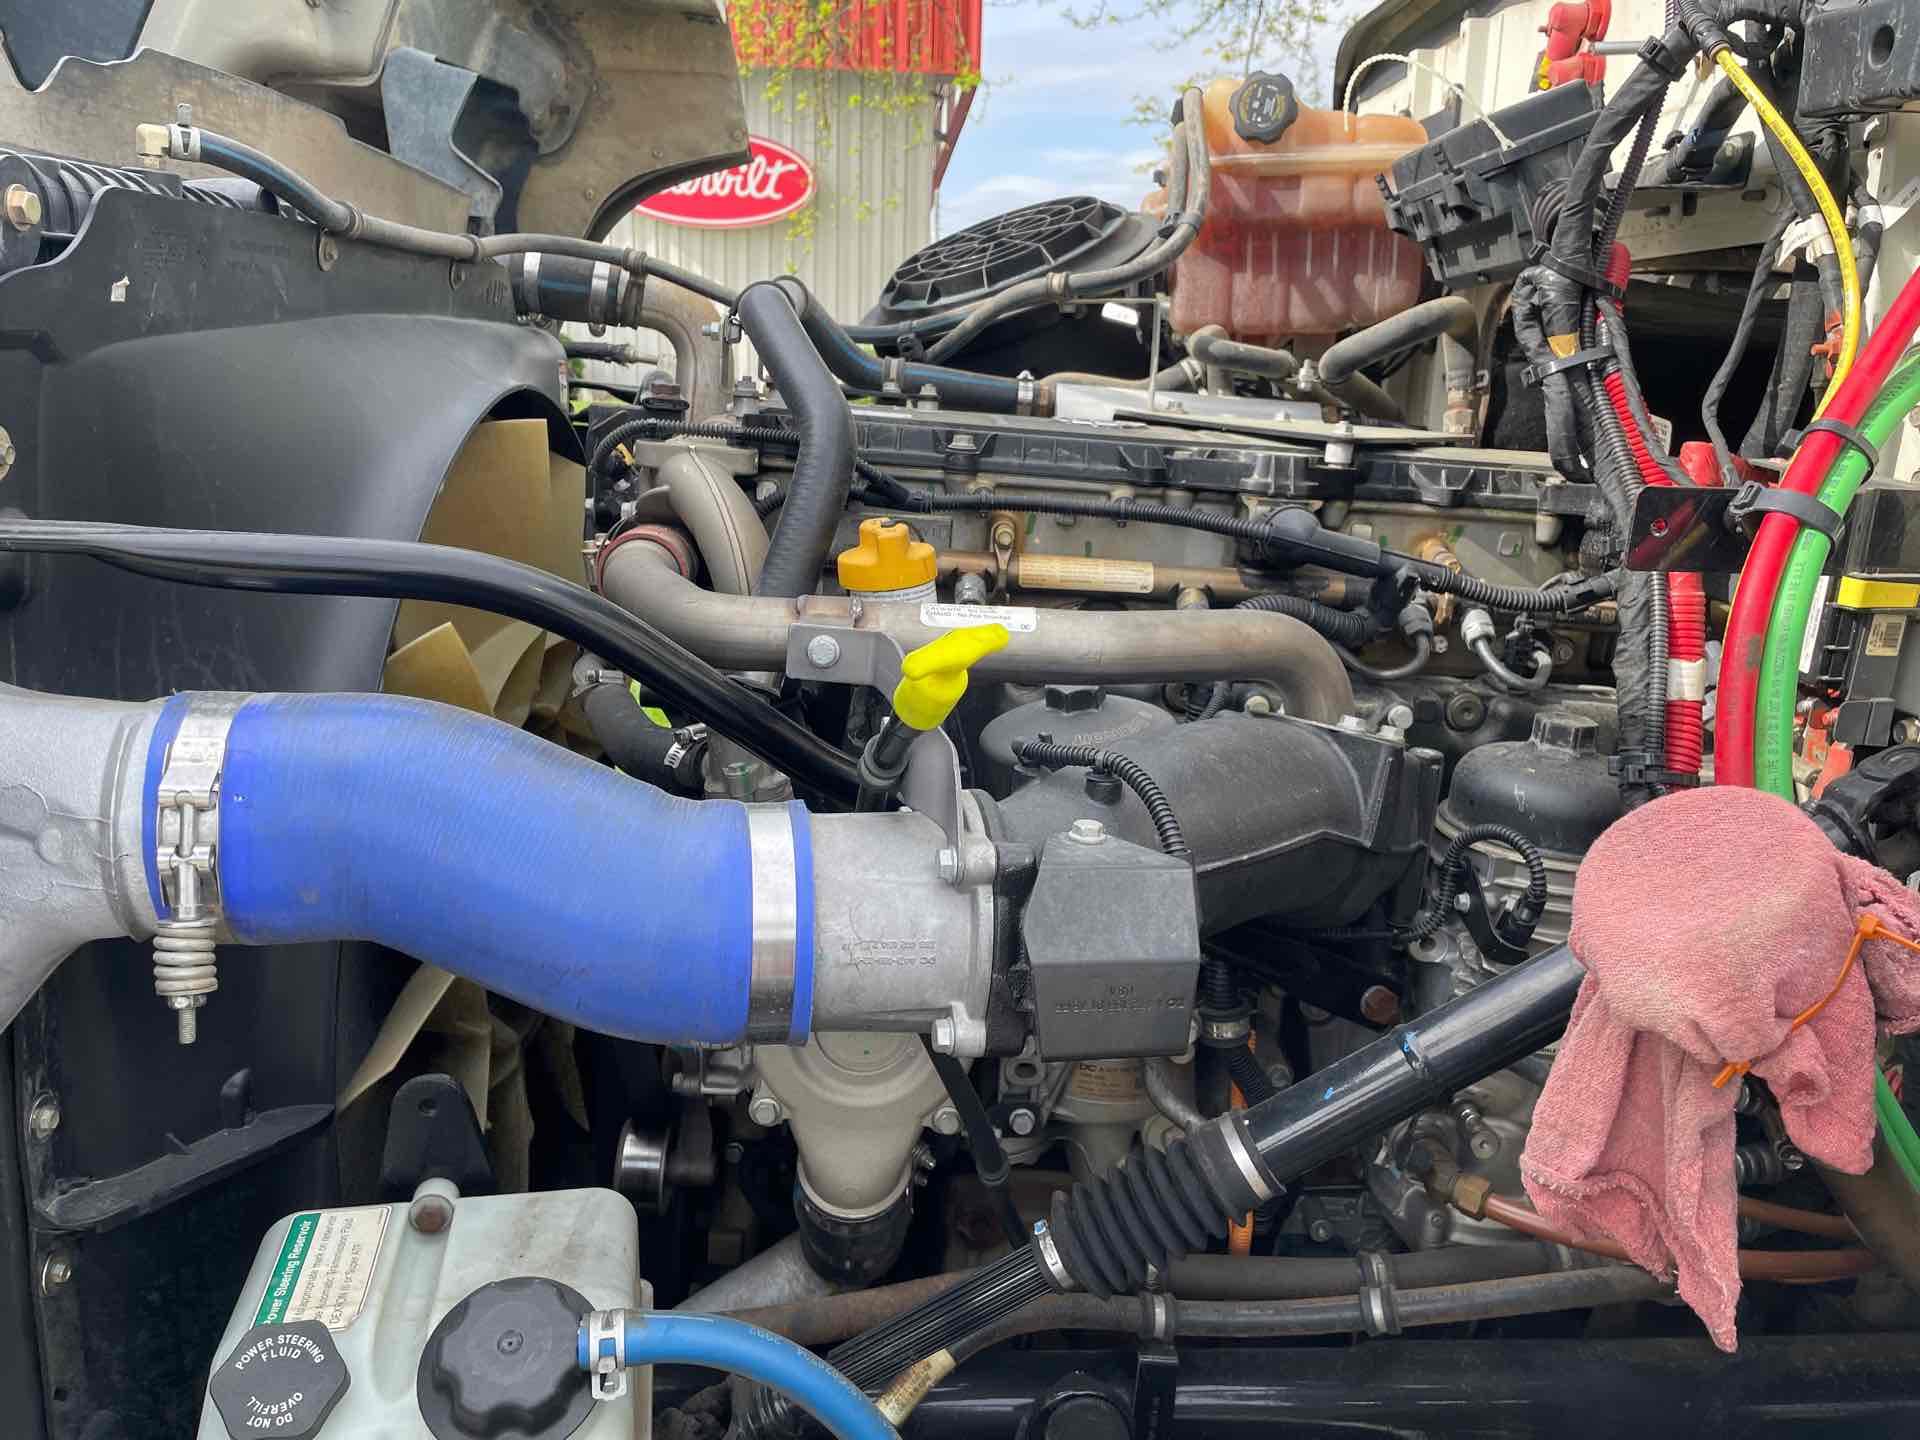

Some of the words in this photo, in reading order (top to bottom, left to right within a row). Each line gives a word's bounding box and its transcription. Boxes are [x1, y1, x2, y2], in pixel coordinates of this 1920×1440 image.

[273, 1260, 300, 1297] Steering
[288, 1220, 313, 1259] Reservoir
[235, 1338, 274, 1370] POWER
[277, 1334, 325, 1364] STEERING
[261, 1346, 301, 1362] FLUID
[246, 1392, 303, 1415] OVERFILL
[246, 1416, 271, 1428] NOT
[275, 1413, 293, 1426] DO
